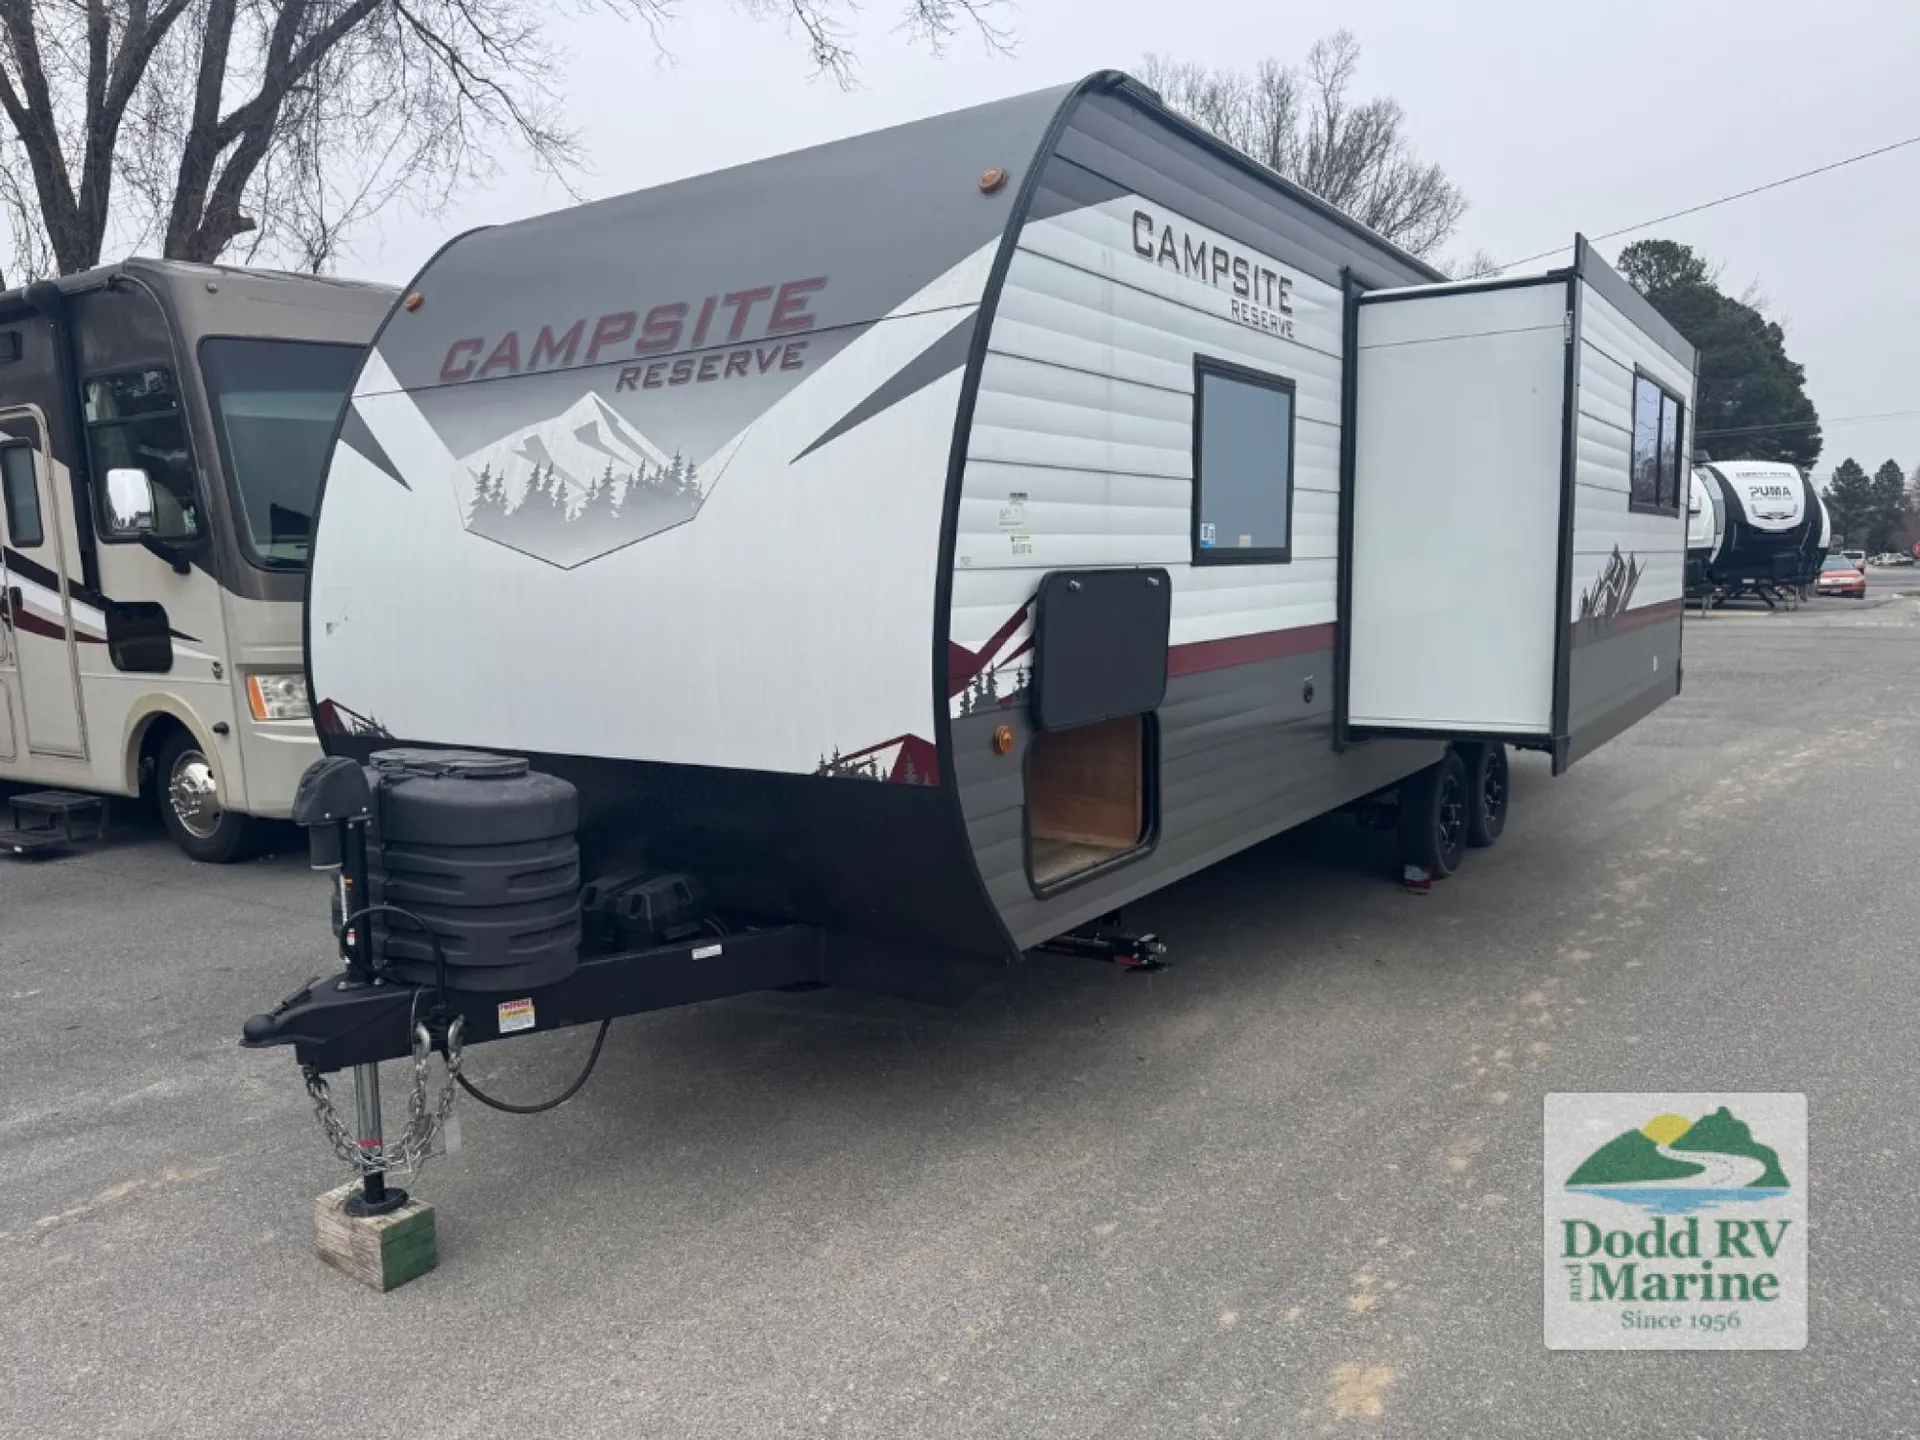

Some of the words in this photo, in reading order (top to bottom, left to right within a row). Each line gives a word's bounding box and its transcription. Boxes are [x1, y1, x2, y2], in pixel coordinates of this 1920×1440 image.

[1132, 209, 1293, 315] CAMPSITE
[438, 274, 829, 383] CAMPSITE
[1230, 298, 1294, 339] RESERVE
[614, 340, 810, 393] RESERVE
[1748, 485, 1791, 497] PUMA
